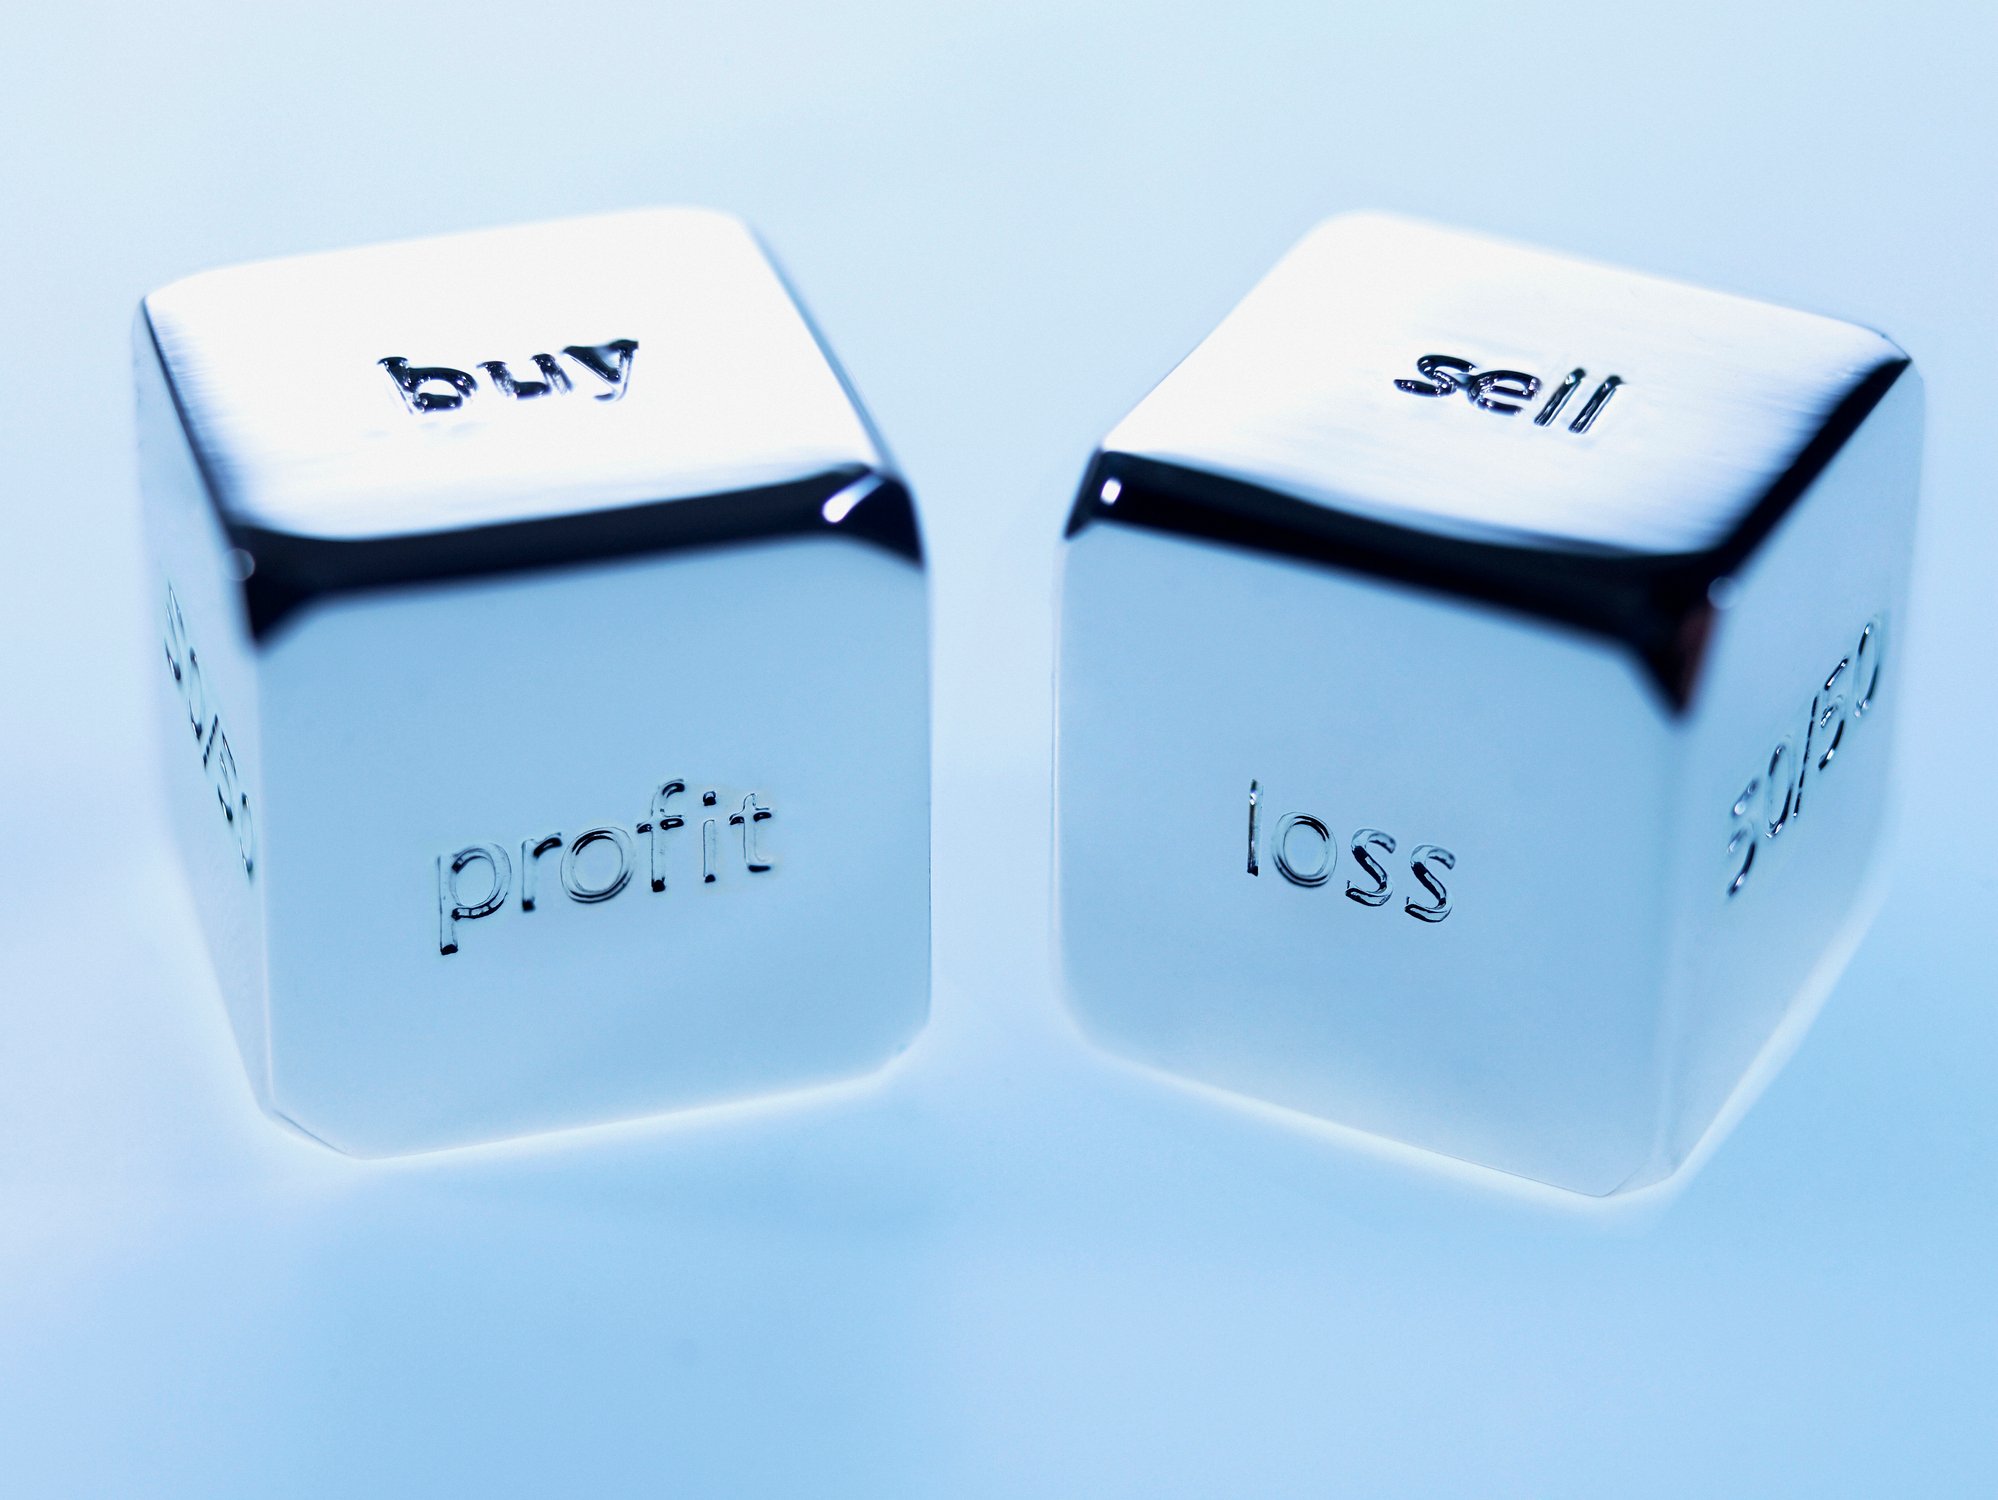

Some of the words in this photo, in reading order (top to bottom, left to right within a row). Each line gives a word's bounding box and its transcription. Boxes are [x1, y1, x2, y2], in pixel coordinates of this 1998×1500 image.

[377, 339, 638, 414] buy
[1393, 354, 1625, 434] sell
[1726, 614, 1881, 898] 50/50
[435, 778, 772, 956] profit
[1246, 778, 1456, 923] loss
